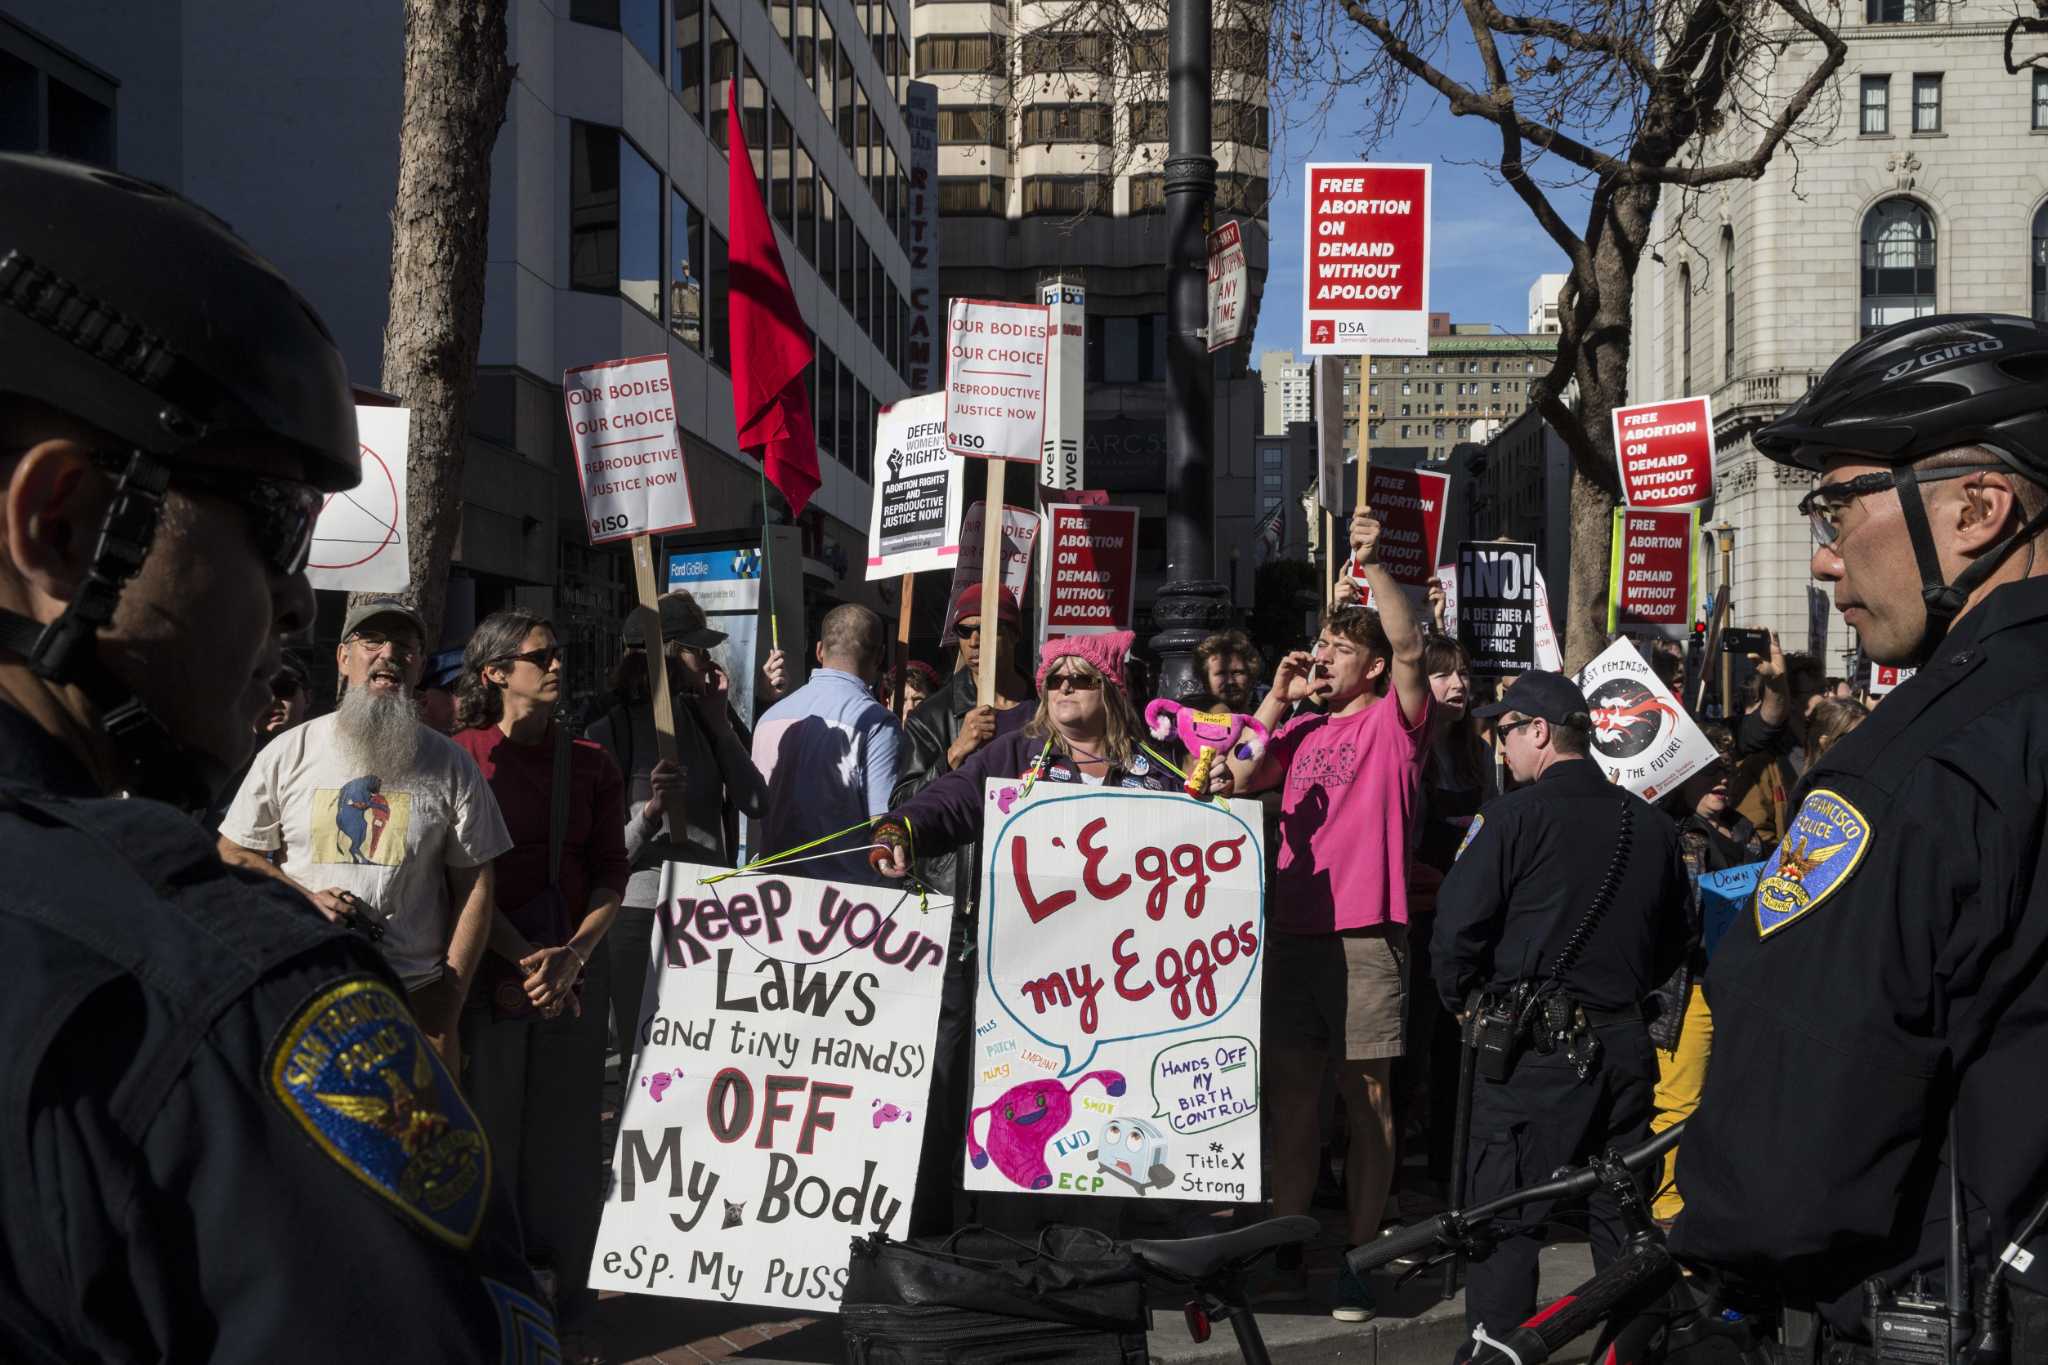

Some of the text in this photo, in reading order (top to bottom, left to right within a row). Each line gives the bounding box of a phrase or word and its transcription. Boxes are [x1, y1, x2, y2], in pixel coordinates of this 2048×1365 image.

[1319, 178, 1365, 193] FREE
[1318, 199, 1411, 215] ABORTION
[1318, 221, 1346, 236] ON
[1318, 242, 1395, 257] DEMAND
[1318, 263, 1401, 279] WITHOUT
[1218, 279, 1237, 299] ANY
[1317, 285, 1402, 300] APOLOGY
[1216, 301, 1237, 324] TIME
[952, 319, 984, 334] OUR
[990, 322, 1046, 339] BODIES
[1338, 321, 1365, 333] DSA
[952, 345, 1044, 366] OUR CHOICE
[1920, 338, 2004, 367] GIRO
[570, 377, 670, 405] OUR BODIES
[953, 382, 1041, 400] REPRODUCTIVE
[954, 404, 1037, 420] JUSTICE NOW
[1623, 412, 1658, 426] FREE
[575, 407, 674, 436] OUR CHOICE
[1624, 421, 1697, 441] ABORTION
[906, 435, 945, 451] WOMEN'
[958, 434, 985, 449] ISO
[1626, 443, 1648, 456] ON
[585, 448, 679, 476] REPRODUCTIVE
[905, 447, 947, 467] RIGHTS
[1061, 439, 1078, 491] well
[1628, 454, 1688, 472] DEMAND
[592, 471, 678, 497] JUSTICE NOW
[885, 474, 945, 495] ABORTION RIGHTS
[1374, 475, 1404, 490] FREE
[1630, 469, 1694, 487] WITHOUT
[905, 489, 921, 500] AND
[1633, 483, 1697, 501] APOLOGY
[883, 495, 944, 517] REPRODUCTIVE
[1371, 493, 1434, 512] ABORTION
[601, 514, 629, 533] ISO
[882, 507, 943, 529] JUSTICE NOW!
[1059, 516, 1090, 529] FREE
[1630, 519, 1657, 531] FREE
[1059, 535, 1124, 548] ABORTION
[1381, 528, 1420, 543] MAND
[1629, 536, 1683, 550] ABORTION
[1058, 552, 1078, 565] ON
[1629, 553, 1646, 566] ON
[671, 561, 709, 577] Ford GoBike
[1057, 569, 1111, 583] DEMAND
[1628, 570, 1673, 583] DEMAND
[1056, 587, 1115, 600] WITHOUT
[1627, 587, 1676, 600] WITHOUT
[1054, 604, 1113, 618] APOLOGY
[1462, 608, 1471, 621] A
[1473, 607, 1522, 623] DETENER
[1524, 608, 1532, 623] A
[1627, 604, 1677, 616] APOLOGY
[1473, 623, 1514, 639] TRUMP
[1514, 624, 1523, 638] Y
[1480, 638, 1516, 654] PENCE
[1602, 659, 1649, 675] FEMINISM
[1626, 767, 1646, 779] THE
[1650, 737, 1683, 772] FUTURE!
[1020, 963, 1105, 1035] my
[976, 1019, 998, 1037] PILLS
[986, 1040, 1017, 1058] PATCH
[1161, 1046, 1248, 1078] HANDS OFF
[1193, 1072, 1213, 1091] MY
[1082, 1097, 1115, 1115] SHOT
[1178, 1086, 1233, 1111] BIRTH
[706, 1067, 854, 1155] OFF
[1174, 1099, 1257, 1130] CONTROL
[1052, 1129, 1091, 1158] IUD
[1208, 1141, 1224, 1154] #
[1058, 1172, 1105, 1193] ECP
[1180, 1173, 1246, 1201] Strong
[687, 1250, 744, 1302] My
